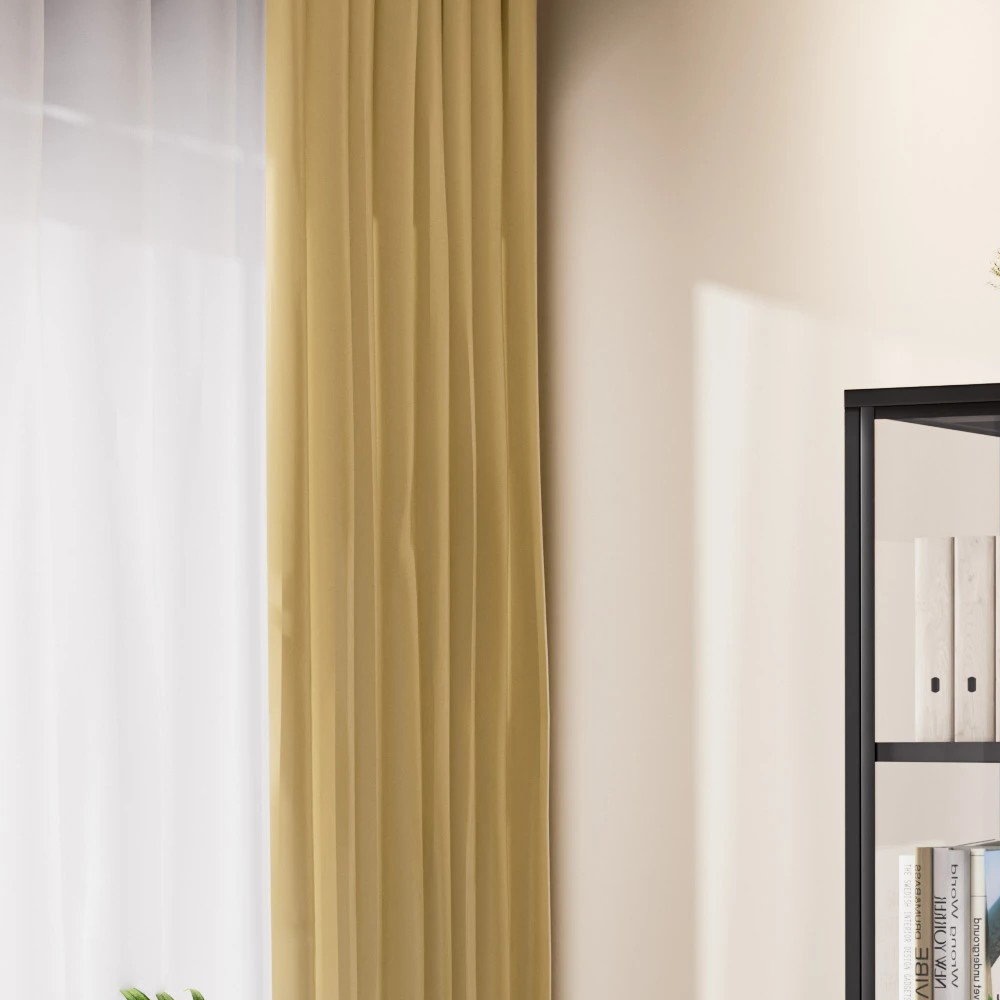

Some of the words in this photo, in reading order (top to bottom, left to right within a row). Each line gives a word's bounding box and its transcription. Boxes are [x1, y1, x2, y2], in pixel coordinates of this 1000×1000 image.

[904, 864, 912, 876] THE
[904, 880, 912, 907] SWEDISH
[904, 912, 912, 943] INTERIOR
[904, 946, 912, 970] DESIGN
[904, 974, 912, 1000] GADGETS
